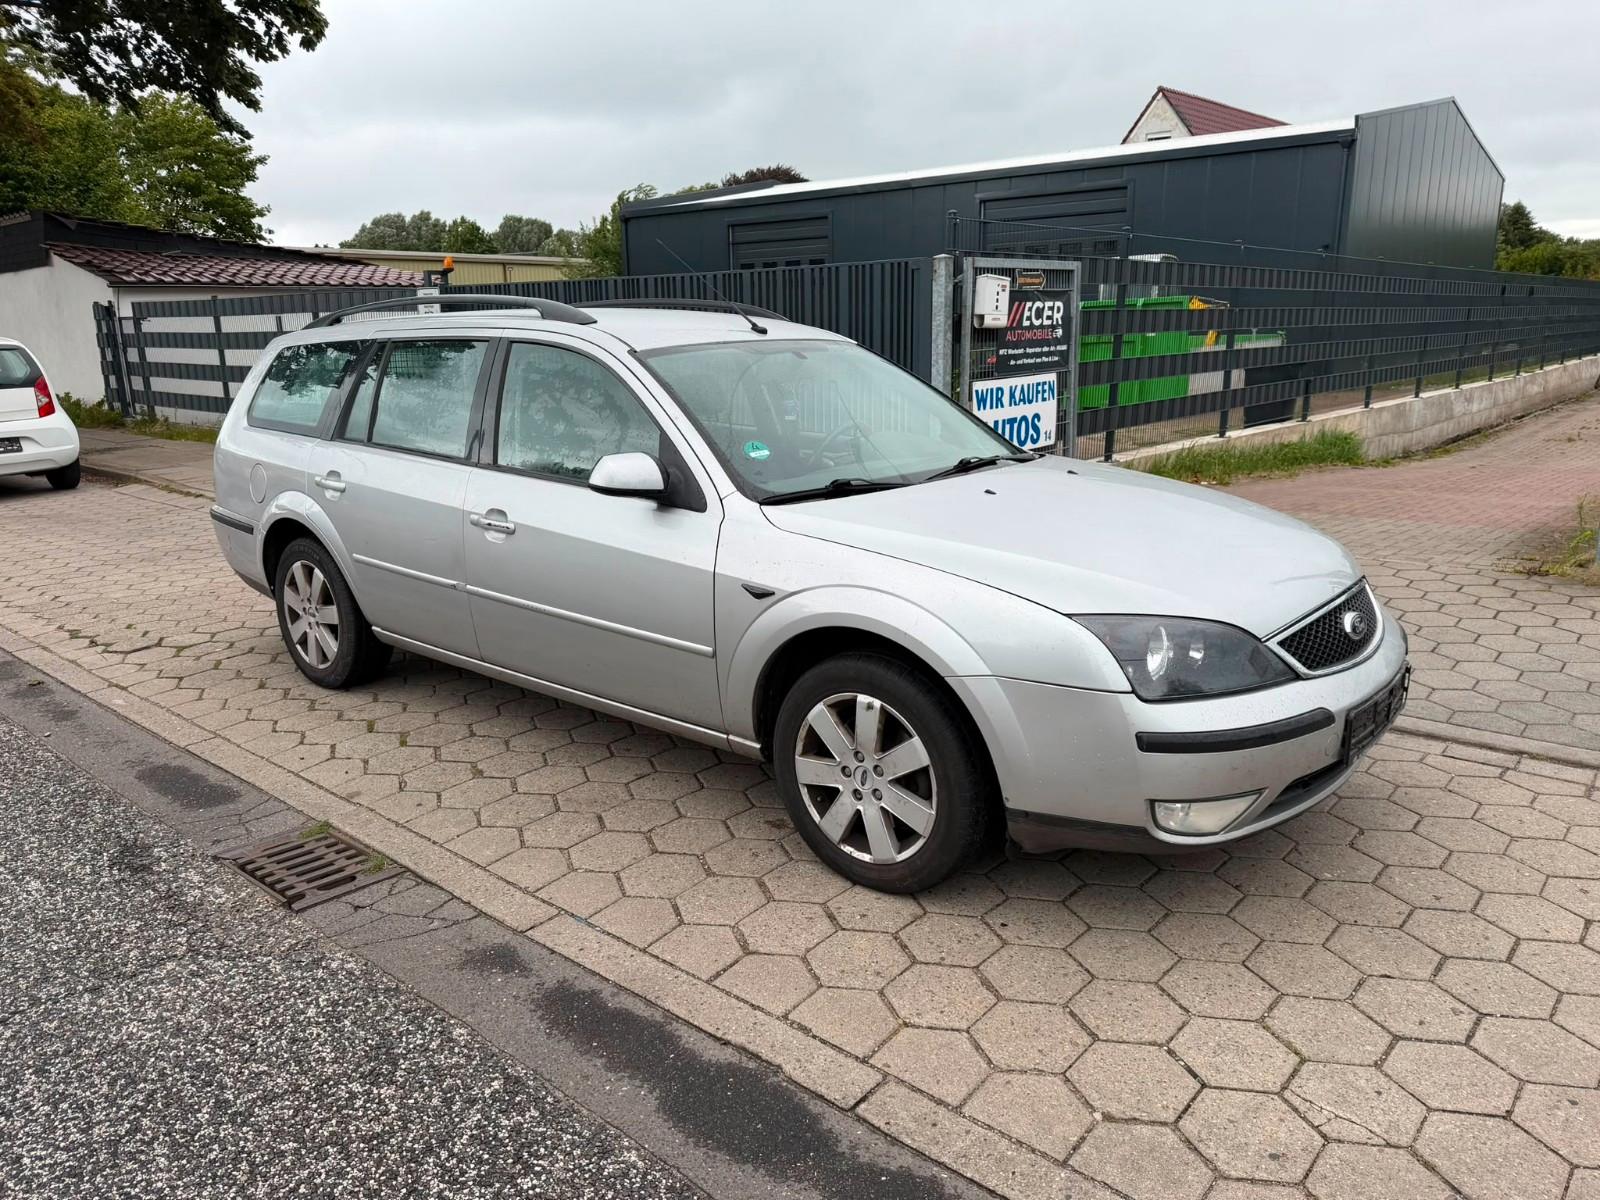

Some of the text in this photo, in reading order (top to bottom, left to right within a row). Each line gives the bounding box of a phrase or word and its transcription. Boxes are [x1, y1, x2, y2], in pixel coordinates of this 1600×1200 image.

[1006, 328, 1052, 341] AUTOMOBILE
[975, 380, 1055, 411] WIR KAUFEN
[986, 413, 1041, 447] TOS
